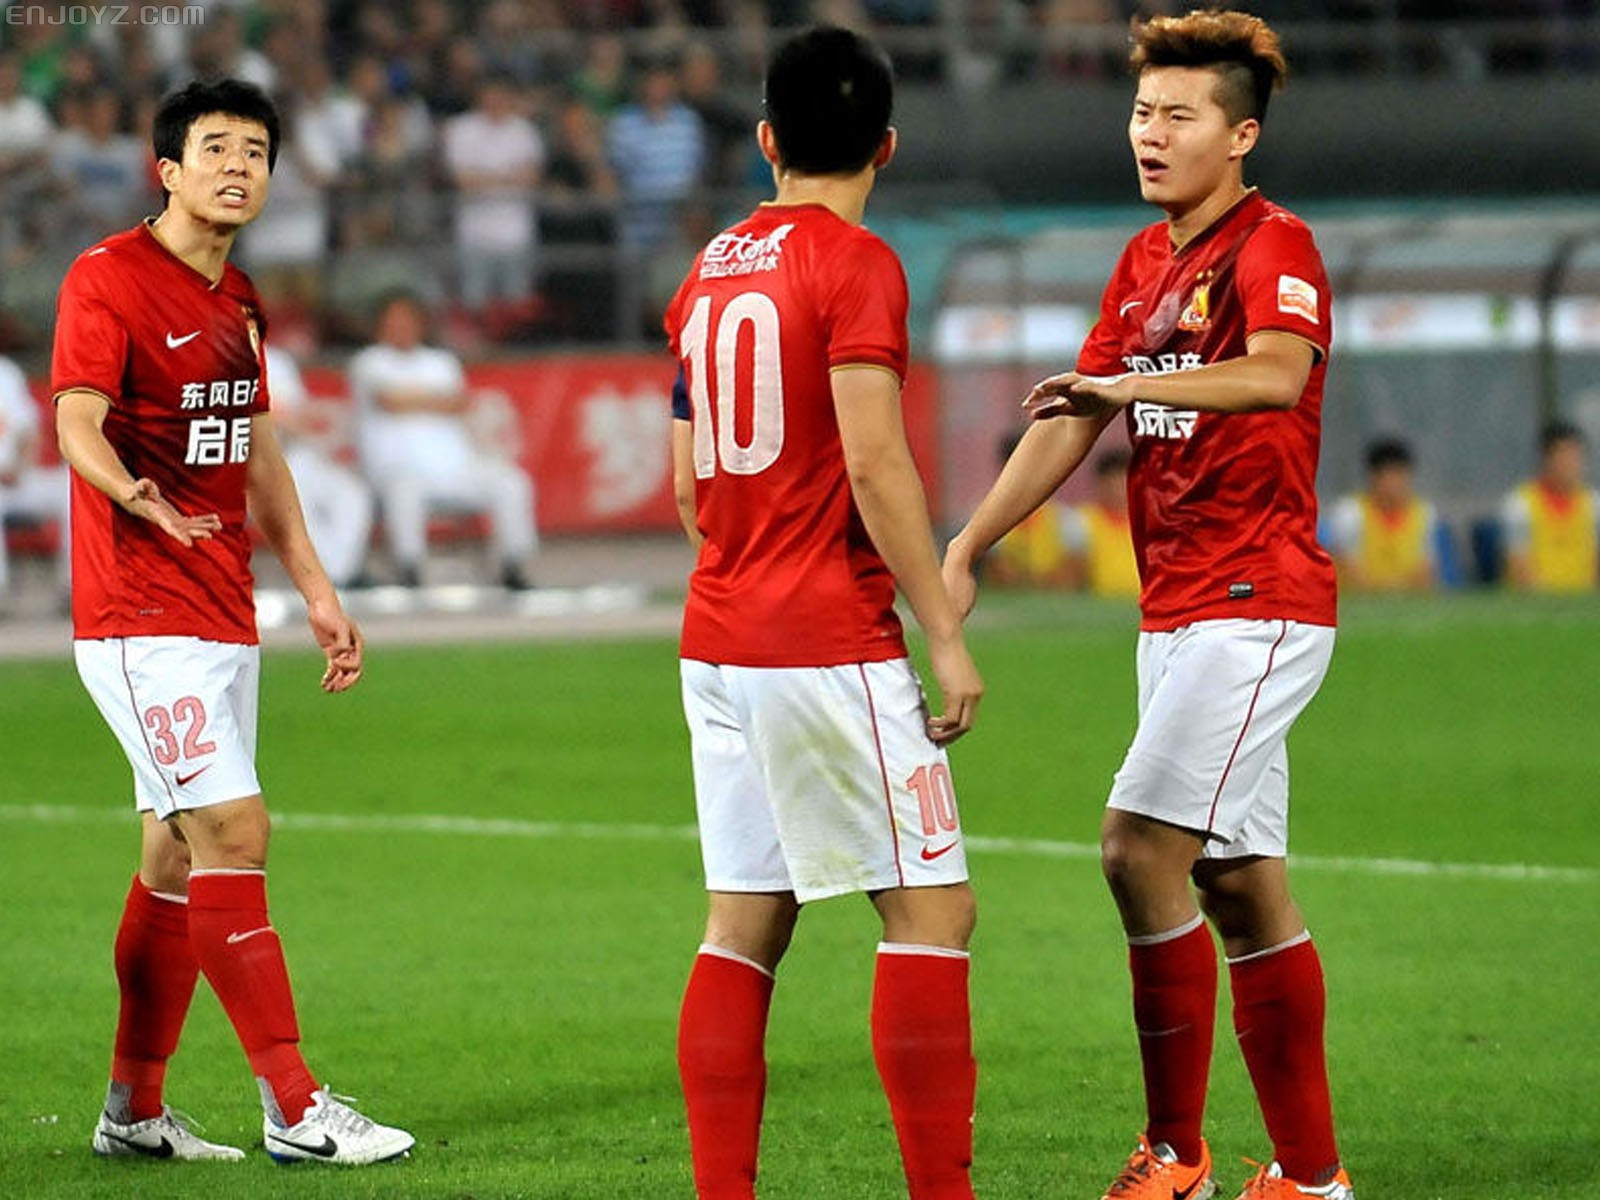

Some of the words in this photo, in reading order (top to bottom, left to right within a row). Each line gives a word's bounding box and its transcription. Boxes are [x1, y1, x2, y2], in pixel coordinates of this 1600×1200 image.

[680, 292, 785, 480] 10
[144, 695, 217, 766] 32
[905, 763, 958, 836] 10
